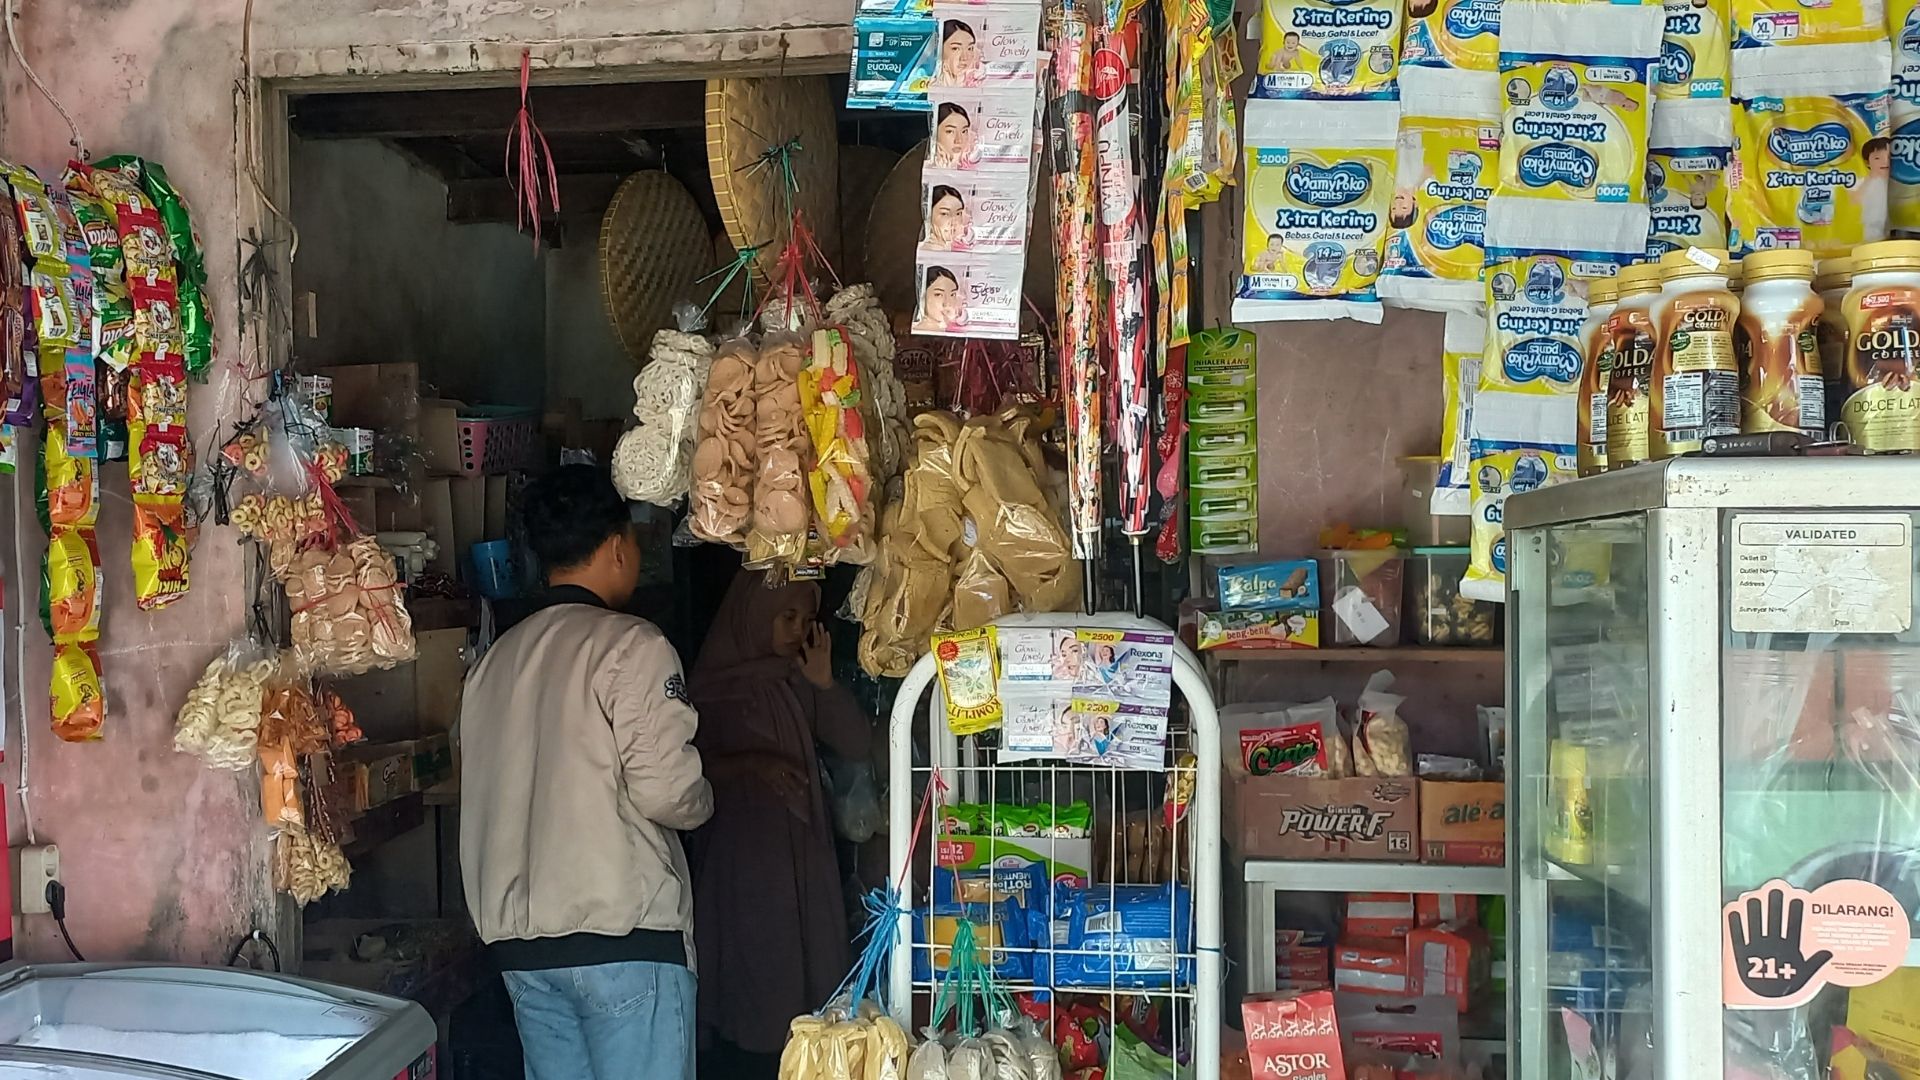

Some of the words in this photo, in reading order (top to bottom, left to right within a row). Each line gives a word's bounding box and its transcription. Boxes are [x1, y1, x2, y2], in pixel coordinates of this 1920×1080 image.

[1293, 8, 1334, 26] X-tra
[1335, 8, 1391, 28] Kering
[1665, 14, 1701, 33] X-tr
[1302, 29, 1326, 37] Bebas
[1327, 30, 1350, 38] Gatal
[1356, 29, 1379, 37] Lecet
[1757, 22, 1770, 33] XL
[992, 35, 1017, 47] Glow
[999, 45, 1030, 58] Lovely
[866, 63, 902, 74] Rexona
[1267, 75, 1276, 86] M
[1624, 71, 1631, 81] S
[1550, 112, 1572, 120] Gatal
[986, 117, 1013, 129] Glow
[1513, 117, 1565, 139] Kering
[994, 129, 1024, 142] Lovely
[1566, 122, 1606, 142] X-tra
[1770, 128, 1849, 155] MamyPoko
[1544, 149, 1574, 160] pants
[1792, 150, 1827, 162] pants
[1706, 158, 1717, 169] M
[1522, 156, 1594, 184] MamyPoko
[1289, 166, 1367, 193] MamyPoko
[1767, 171, 1805, 188] X-tra
[1805, 170, 1856, 187] Kering
[1310, 190, 1344, 202] pants
[1427, 181, 1473, 201] Kering
[980, 201, 1006, 212] Glow
[1663, 204, 1690, 212] Bebas
[987, 213, 1018, 225] Lovely
[1277, 209, 1317, 228] X-tra
[1319, 209, 1376, 232] Kering
[1453, 212, 1483, 223] pants
[1430, 219, 1485, 239] amyPoko
[1657, 215, 1701, 235] X-tra
[1285, 231, 1311, 239] Bebas
[1312, 231, 1336, 240] Gatal
[1342, 232, 1364, 240] Lecet
[1759, 236, 1772, 248] XL
[1610, 265, 1617, 275] S
[1251, 276, 1261, 287] M
[1509, 306, 1531, 314] Lecet
[1684, 310, 1731, 323] GOLDA
[1497, 313, 1551, 334] Kering
[1856, 329, 1920, 352] GOLD
[1529, 343, 1560, 354] pants
[1507, 351, 1579, 380] MamyPoko
[1613, 367, 1646, 378] OFFEE
[1853, 399, 1896, 413] DOLCE
[1785, 530, 1857, 540] VALIDATED
[1091, 633, 1114, 641] 2500
[1226, 624, 1271, 639] beng-beng
[1130, 648, 1163, 659] Rexona
[948, 697, 1001, 720] KOMPLIT
[1124, 719, 1159, 731] Rexona
[951, 843, 963, 855] 12
[1390, 838, 1408, 850] 15
[1004, 880, 1033, 891] ROTI
[1811, 903, 1894, 918] DILARANG!
[1747, 956, 1797, 980] 21+
[1264, 1053, 1331, 1077] ASTOR
